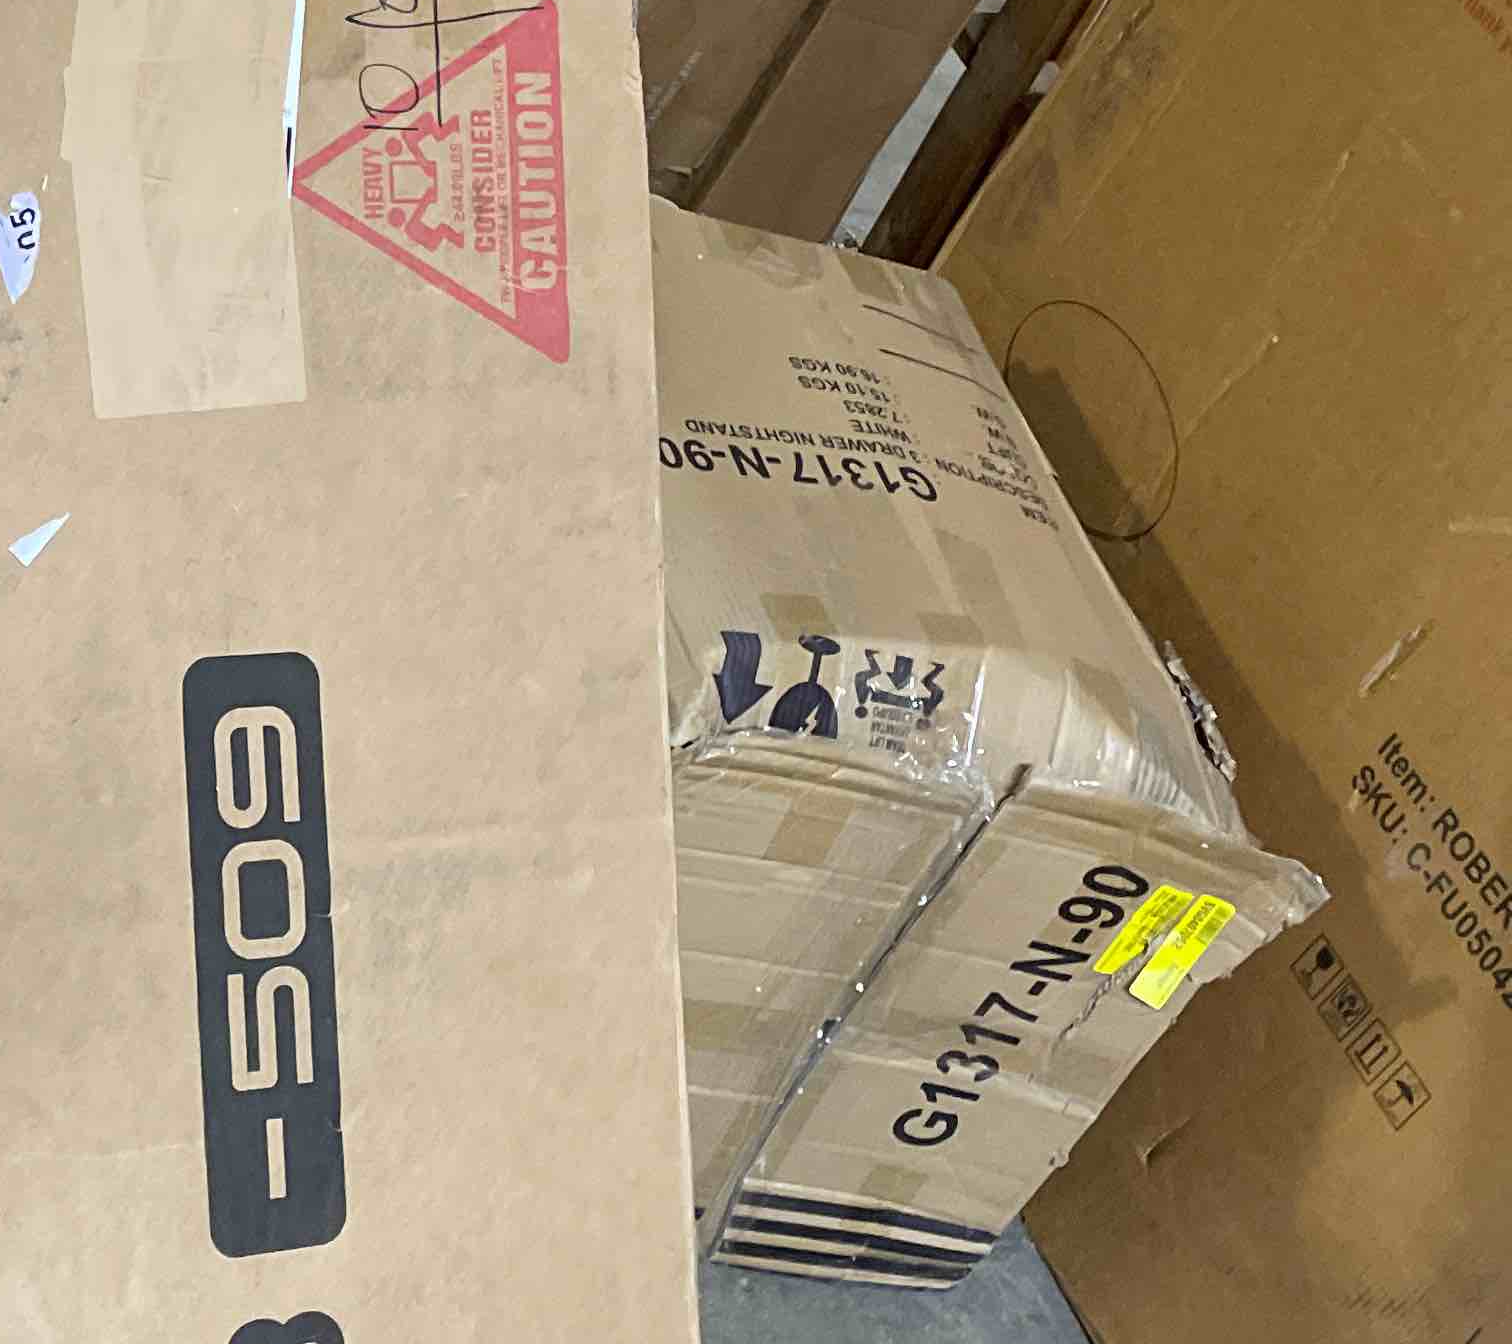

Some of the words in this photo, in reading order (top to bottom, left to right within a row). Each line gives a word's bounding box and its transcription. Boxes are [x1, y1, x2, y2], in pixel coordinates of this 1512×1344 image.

[360, 146, 386, 220] HEAVY
[472, 108, 497, 255] CONSIDER
[511, 71, 558, 292] CAUTION
[685, 418, 815, 446] NIGHTSTAND
[1351, 765, 1409, 845] SKU:
[1377, 732, 1436, 813] Item:
[892, 864, 1150, 1147] G1317-N-90
